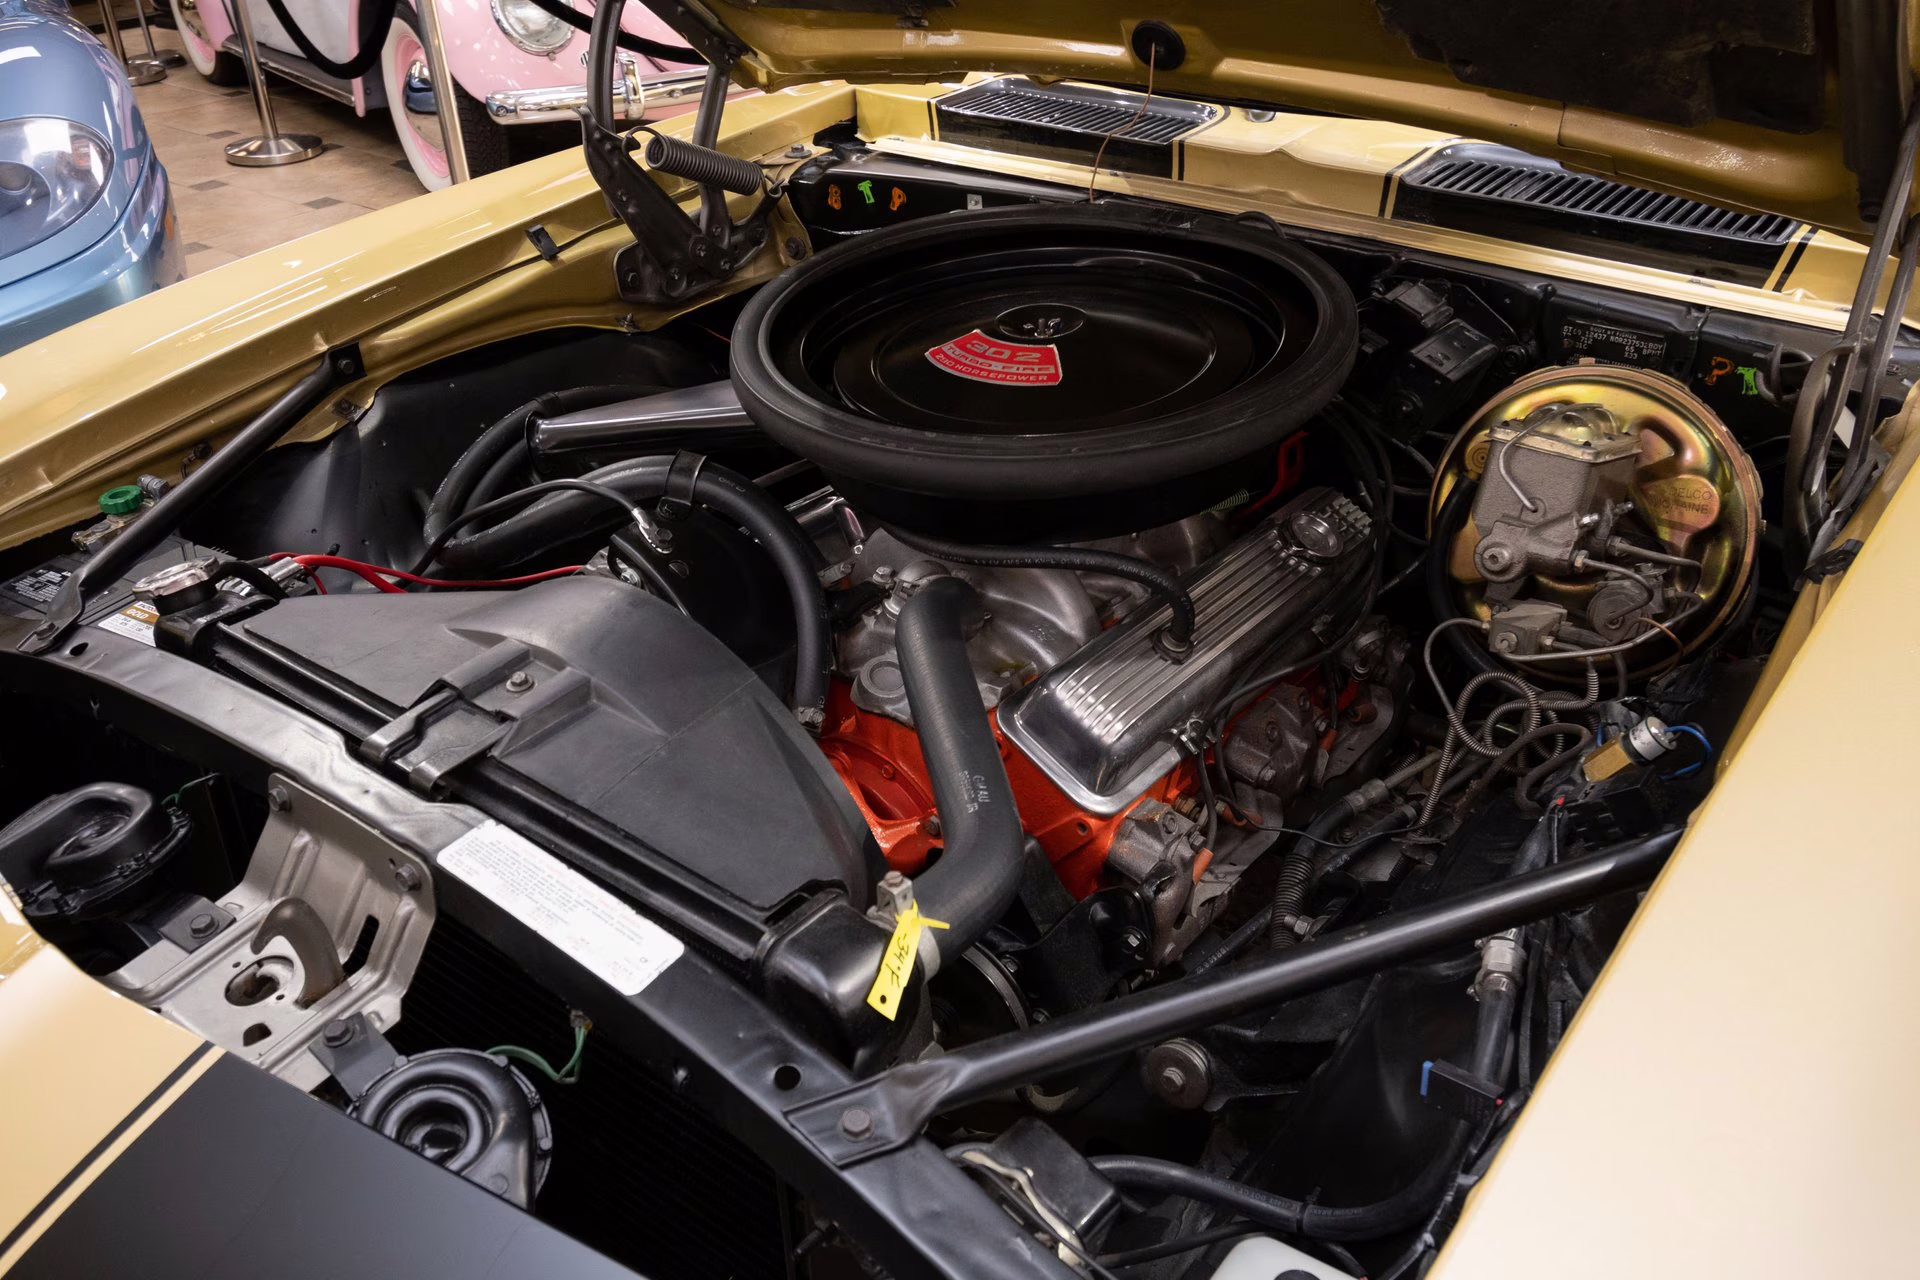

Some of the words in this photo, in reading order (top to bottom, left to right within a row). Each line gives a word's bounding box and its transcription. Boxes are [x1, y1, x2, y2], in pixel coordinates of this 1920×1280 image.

[889, 186, 907, 211] P
[1585, 331, 1607, 341] 12437
[944, 343, 1054, 374] TURBO-FIRE
[966, 339, 1041, 362] 302
[935, 353, 955, 367] 290
[955, 363, 1048, 381] HORSEPOWER
[1670, 487, 1713, 500] DELCO
[127, 608, 149, 619] GOLD
